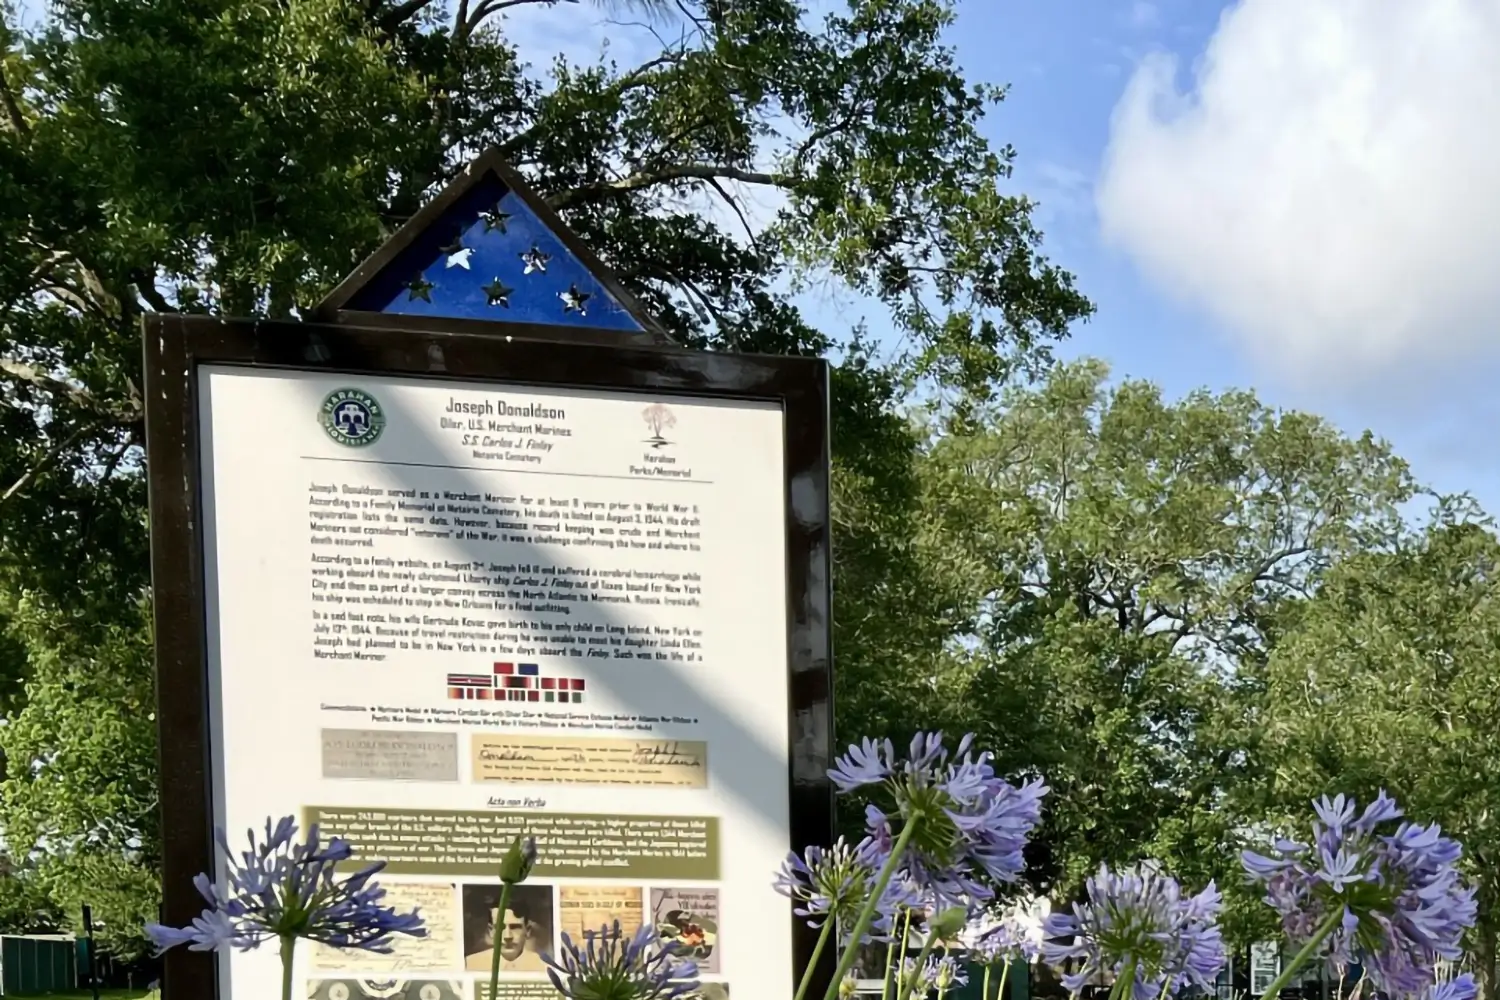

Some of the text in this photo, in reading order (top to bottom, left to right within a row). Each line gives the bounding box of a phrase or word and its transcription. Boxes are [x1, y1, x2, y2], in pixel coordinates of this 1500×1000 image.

[324, 391, 378, 414] HARAHAN
[446, 397, 565, 419] Joseph Donaldson
[469, 420, 485, 430] U.S.
[489, 420, 532, 433] Merchant
[535, 424, 572, 436] Marines
[462, 434, 479, 445] S.S.
[482, 436, 512, 447] Carlos
[527, 439, 553, 452] Finlay
[473, 450, 541, 464] Metairie Cemetery
[644, 454, 675, 464] Harahan
[630, 465, 691, 477] Parks/Memorial
[488, 796, 505, 806] Acta
[524, 798, 546, 807] Verba
